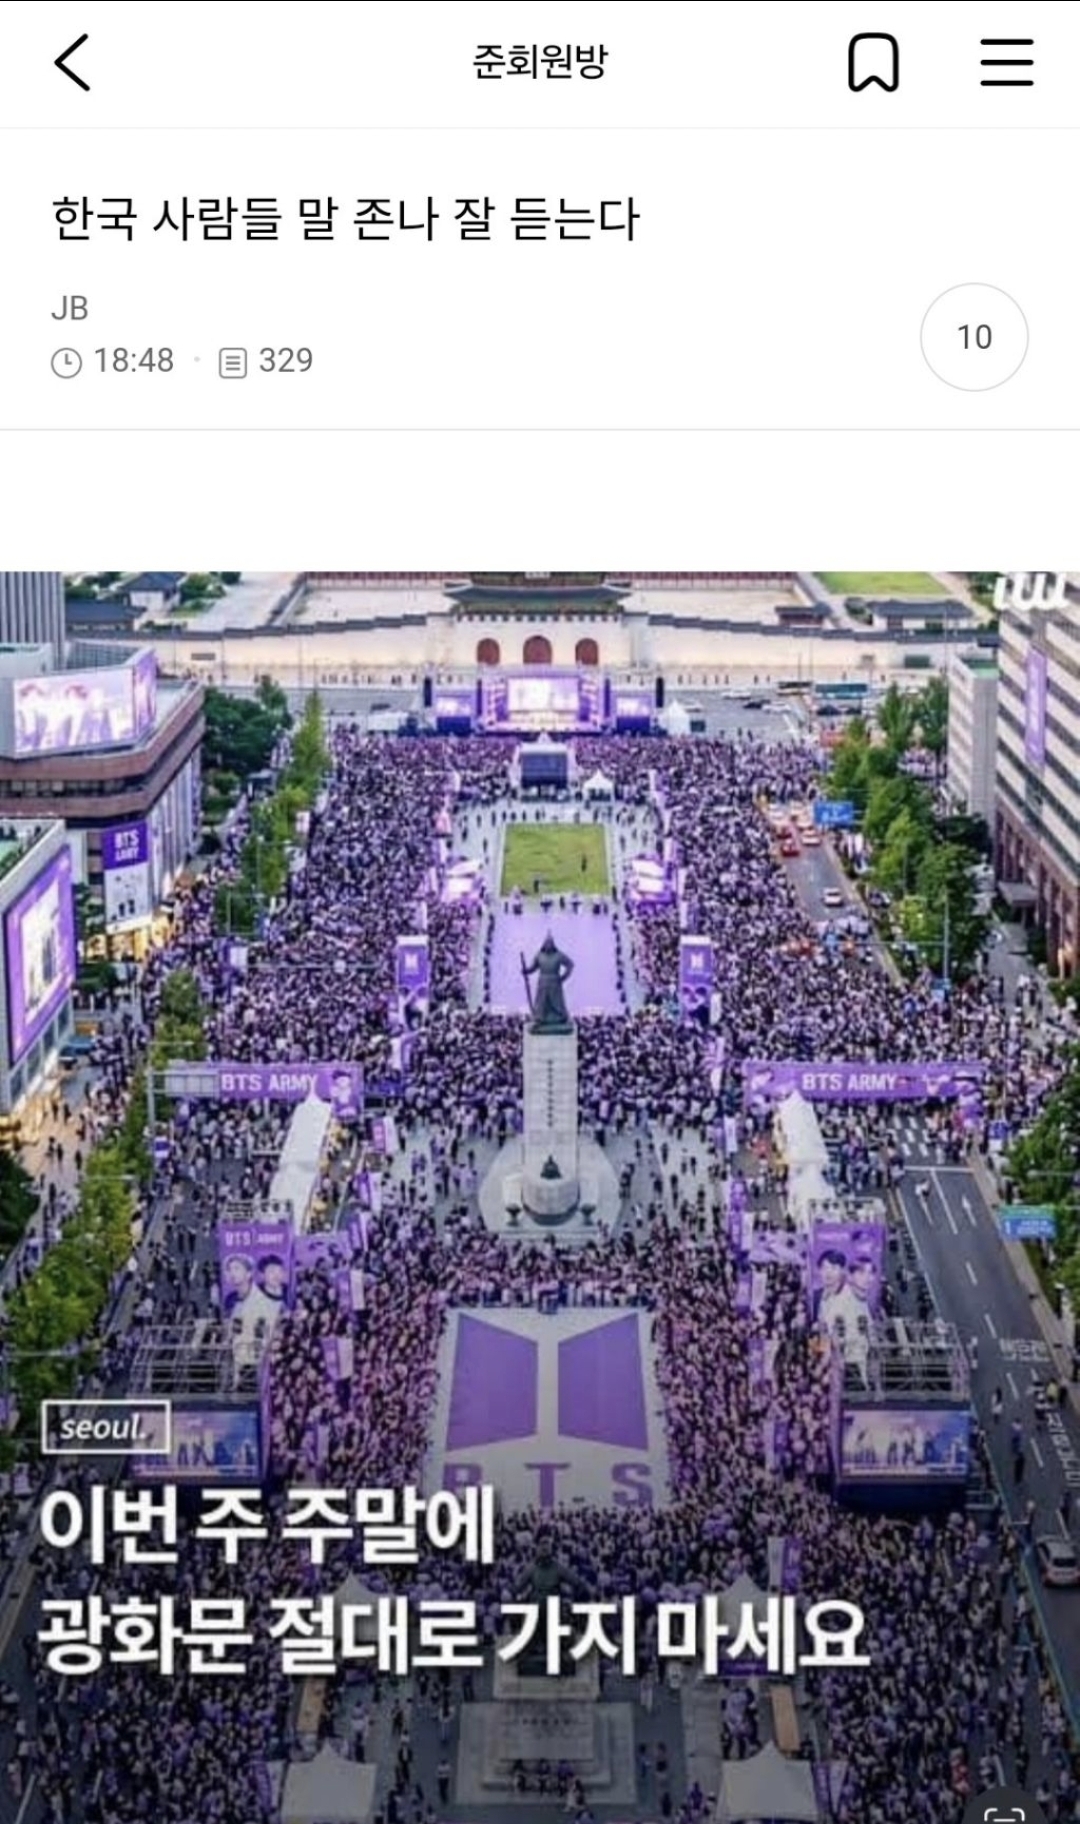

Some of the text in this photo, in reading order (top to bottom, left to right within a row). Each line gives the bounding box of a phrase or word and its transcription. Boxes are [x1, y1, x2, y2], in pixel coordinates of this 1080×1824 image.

[472, 44, 609, 80] 준회원방
[52, 196, 641, 242] 한국 사람들 말 존나 잘 듣는다
[51, 295, 88, 321] JB
[957, 323, 993, 350] 10
[94, 347, 174, 373] 18:48
[259, 347, 313, 373] 329
[221, 1073, 318, 1092] BTS ARMY
[802, 1072, 898, 1091] BTS ARMY
